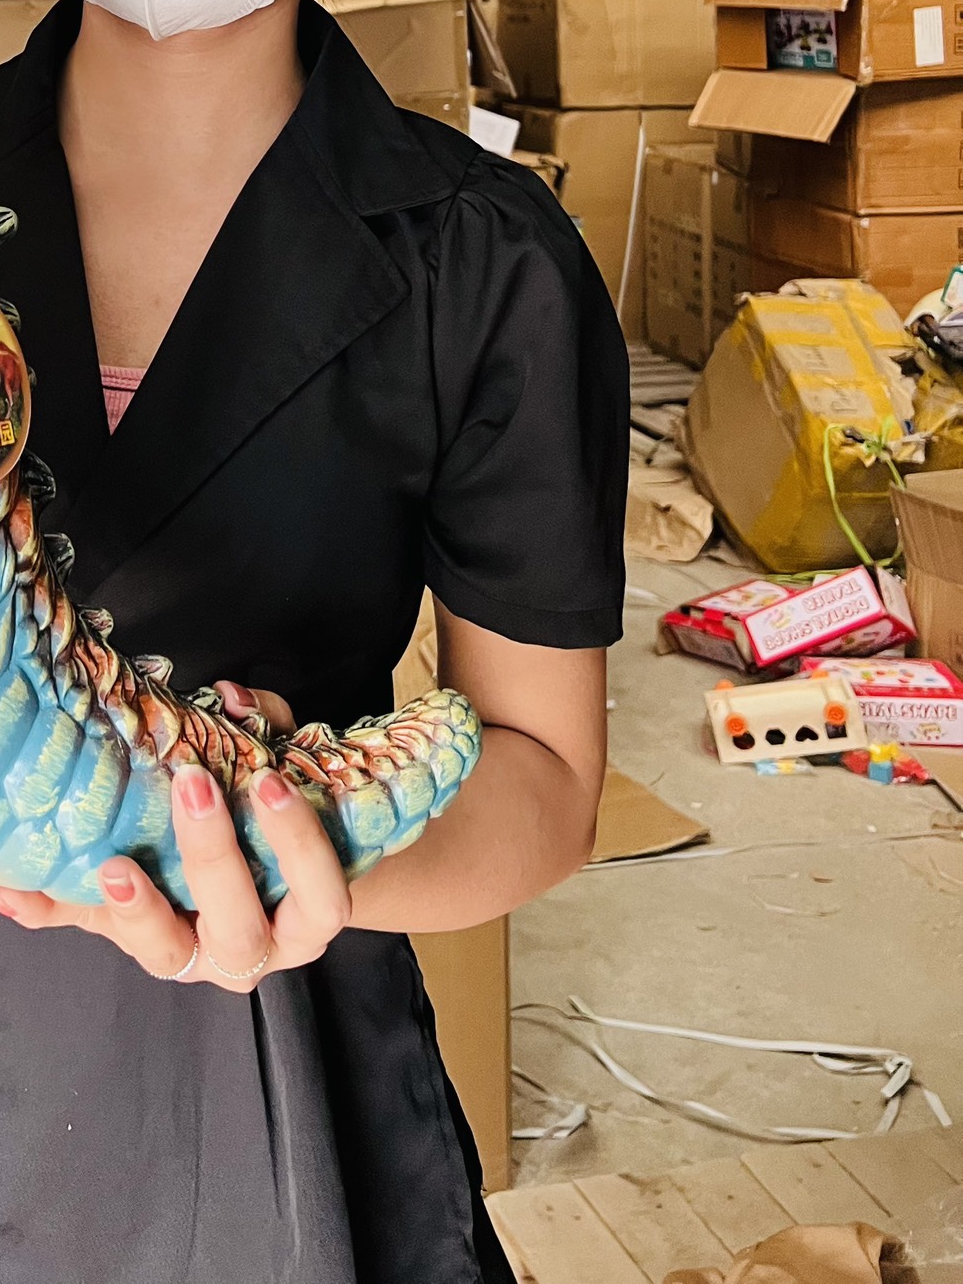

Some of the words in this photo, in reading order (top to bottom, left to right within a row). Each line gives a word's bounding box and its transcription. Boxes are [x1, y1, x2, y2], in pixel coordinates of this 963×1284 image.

[803, 578, 861, 612] TRAINER
[813, 596, 869, 631] DIGITAL
[764, 620, 813, 651] SHAPE
[900, 702, 958, 721] SHAPE
